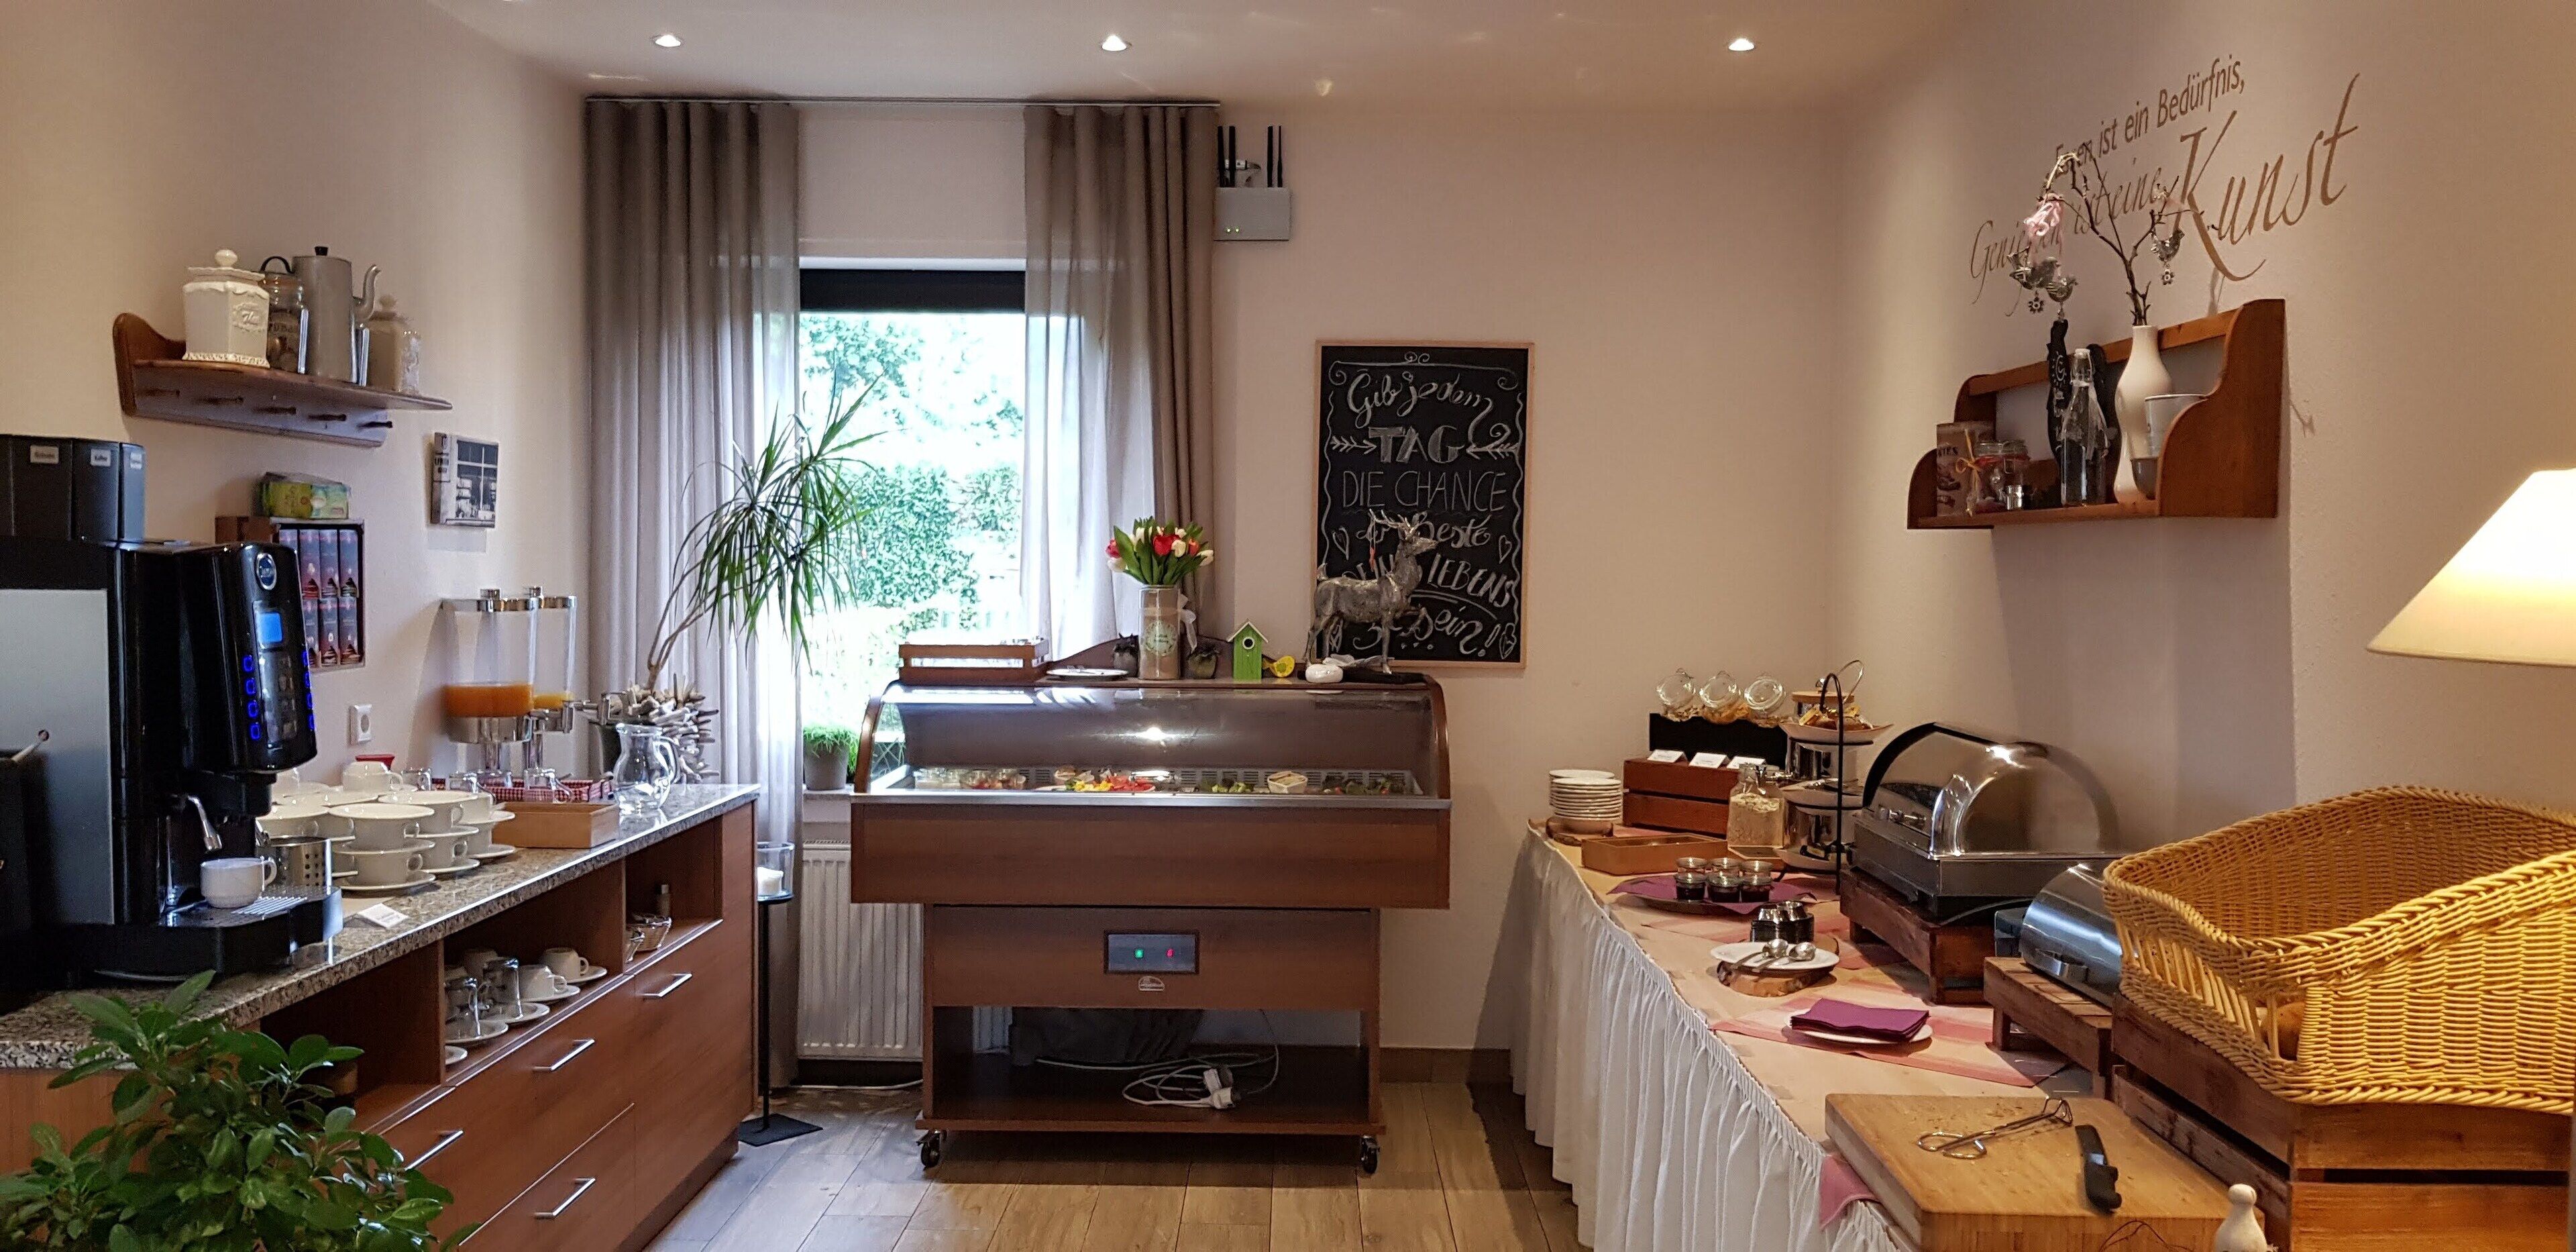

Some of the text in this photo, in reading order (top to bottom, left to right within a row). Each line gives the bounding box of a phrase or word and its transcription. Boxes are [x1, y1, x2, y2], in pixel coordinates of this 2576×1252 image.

[2098, 117, 2118, 158] ist
[2124, 101, 2149, 142] ein
[2156, 53, 2245, 128] Bedürfnis,
[2172, 72, 2361, 282] Kunst
[1346, 368, 1403, 429] Gib
[1367, 425, 1465, 464] TAG
[1342, 469, 1507, 512] DIE CHANCE
